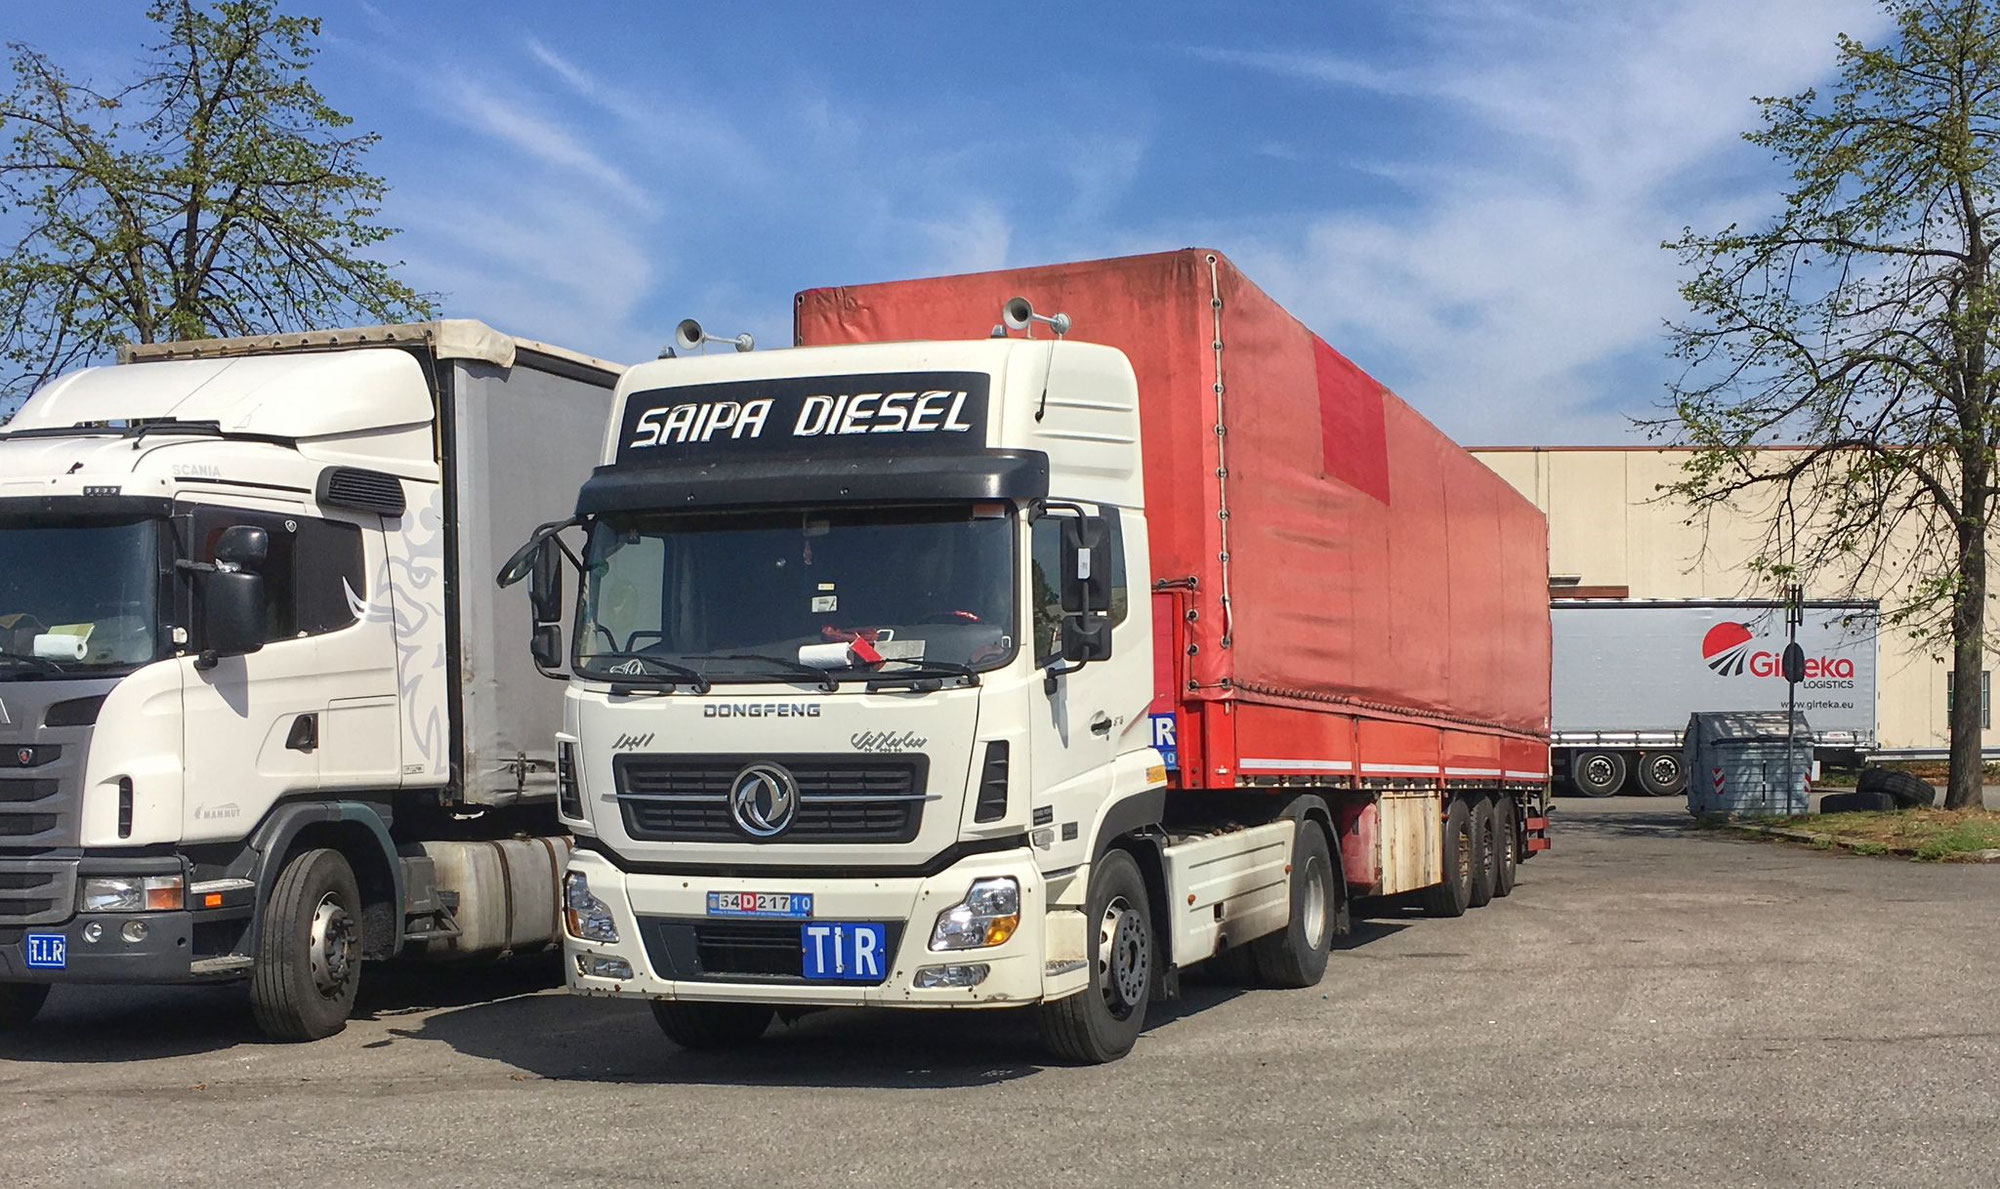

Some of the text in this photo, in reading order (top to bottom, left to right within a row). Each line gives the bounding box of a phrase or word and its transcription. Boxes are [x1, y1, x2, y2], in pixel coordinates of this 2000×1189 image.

[630, 390, 972, 448] SAIPA DIESEL
[172, 464, 222, 477] SCANIA
[1750, 651, 1854, 678] Gieka
[1803, 680, 1854, 689] LOGISTICS
[704, 703, 821, 718] DONGFENG
[203, 809, 241, 820] MAMMUT
[31, 940, 63, 961] T.I.R
[807, 926, 878, 975] TIR
